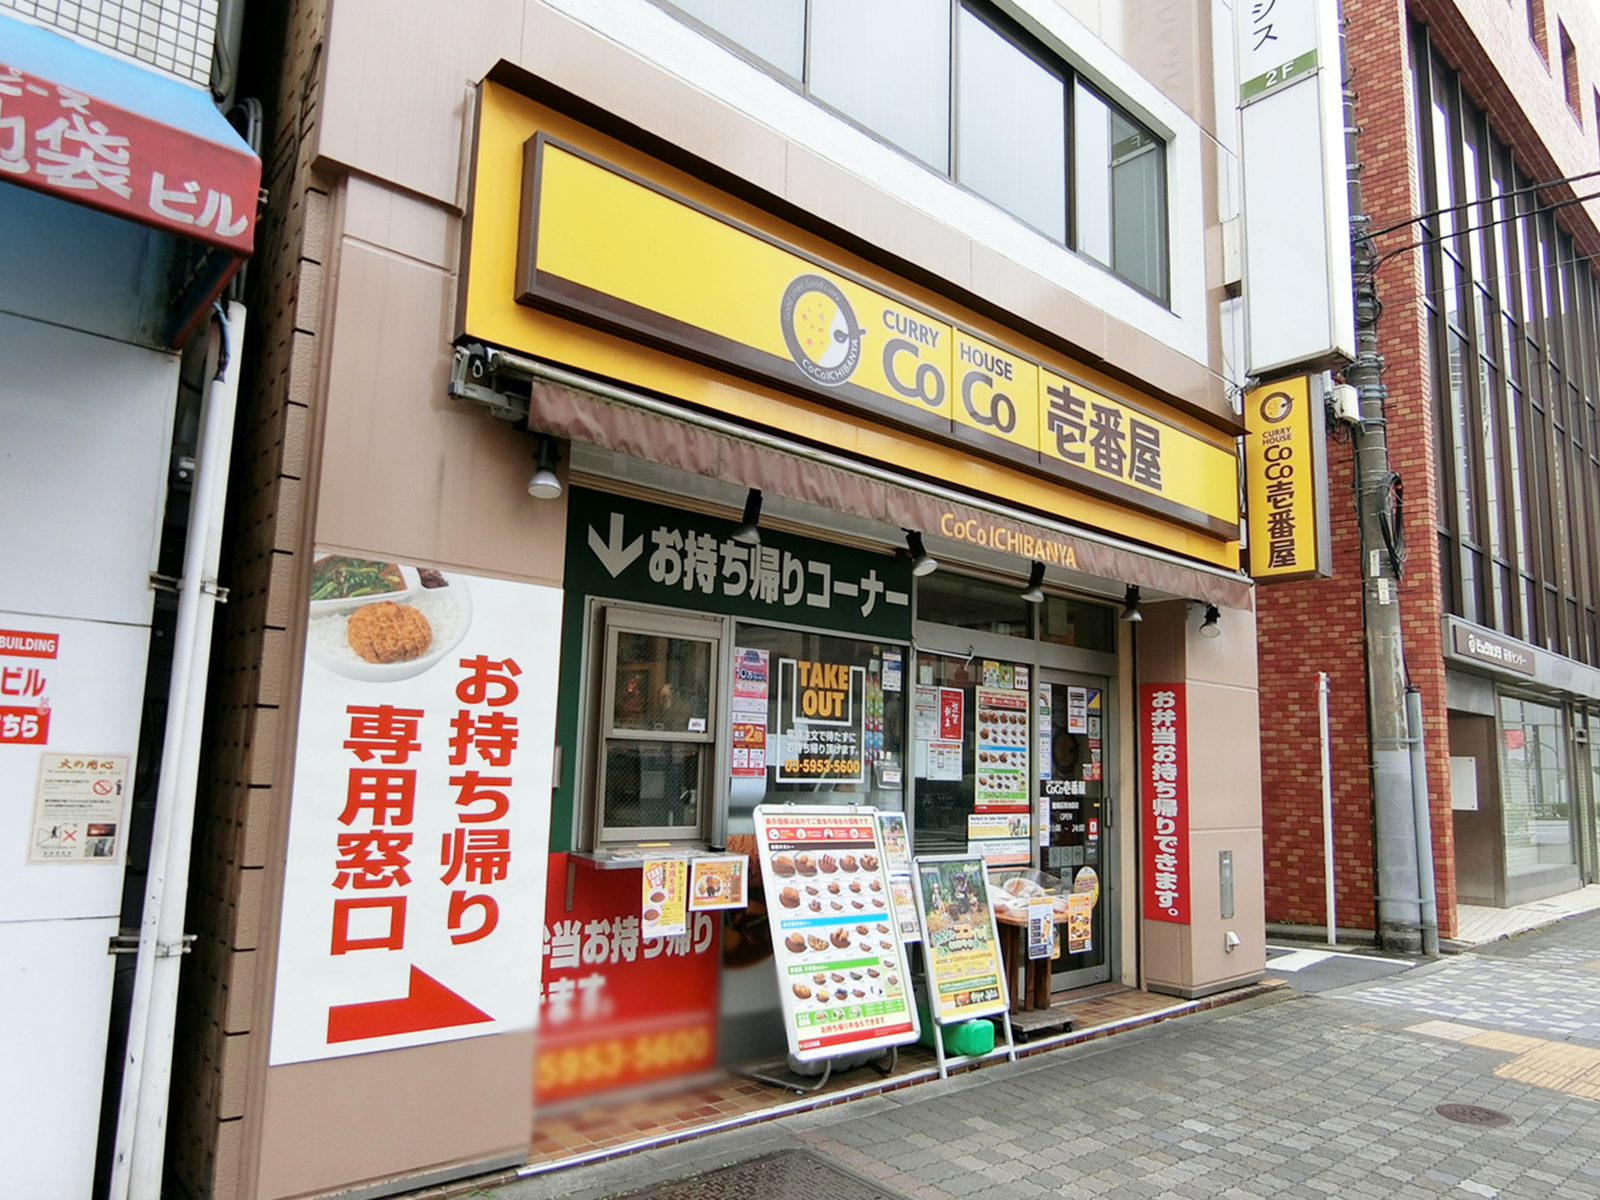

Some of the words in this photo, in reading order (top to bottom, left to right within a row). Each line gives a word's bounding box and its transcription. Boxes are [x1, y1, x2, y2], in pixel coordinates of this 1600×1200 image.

[1265, 61, 1295, 88] 2F
[882, 308, 940, 349] CURRY
[959, 341, 1013, 382] HOUSE
[1046, 384, 1163, 492] 壱番屋
[1262, 426, 1292, 439] CURRY
[1262, 432, 1293, 447] HOUSE
[1265, 480, 1297, 569] 壱番屋
[648, 525, 909, 619] お持ち帰りコーナー
[0, 635, 56, 653] BUILDING
[1, 666, 47, 697] ビル
[798, 660, 849, 691] TAKE
[802, 688, 845, 718] OUT
[0, 713, 39, 739] ちら
[58, 758, 115, 770] 火の用心
[439, 654, 524, 946] お持ち帰り
[1151, 690, 1179, 917] お弁当お持ち帰りできます。
[329, 703, 425, 956] 専用窓口
[540, 972, 615, 1023] ます。
